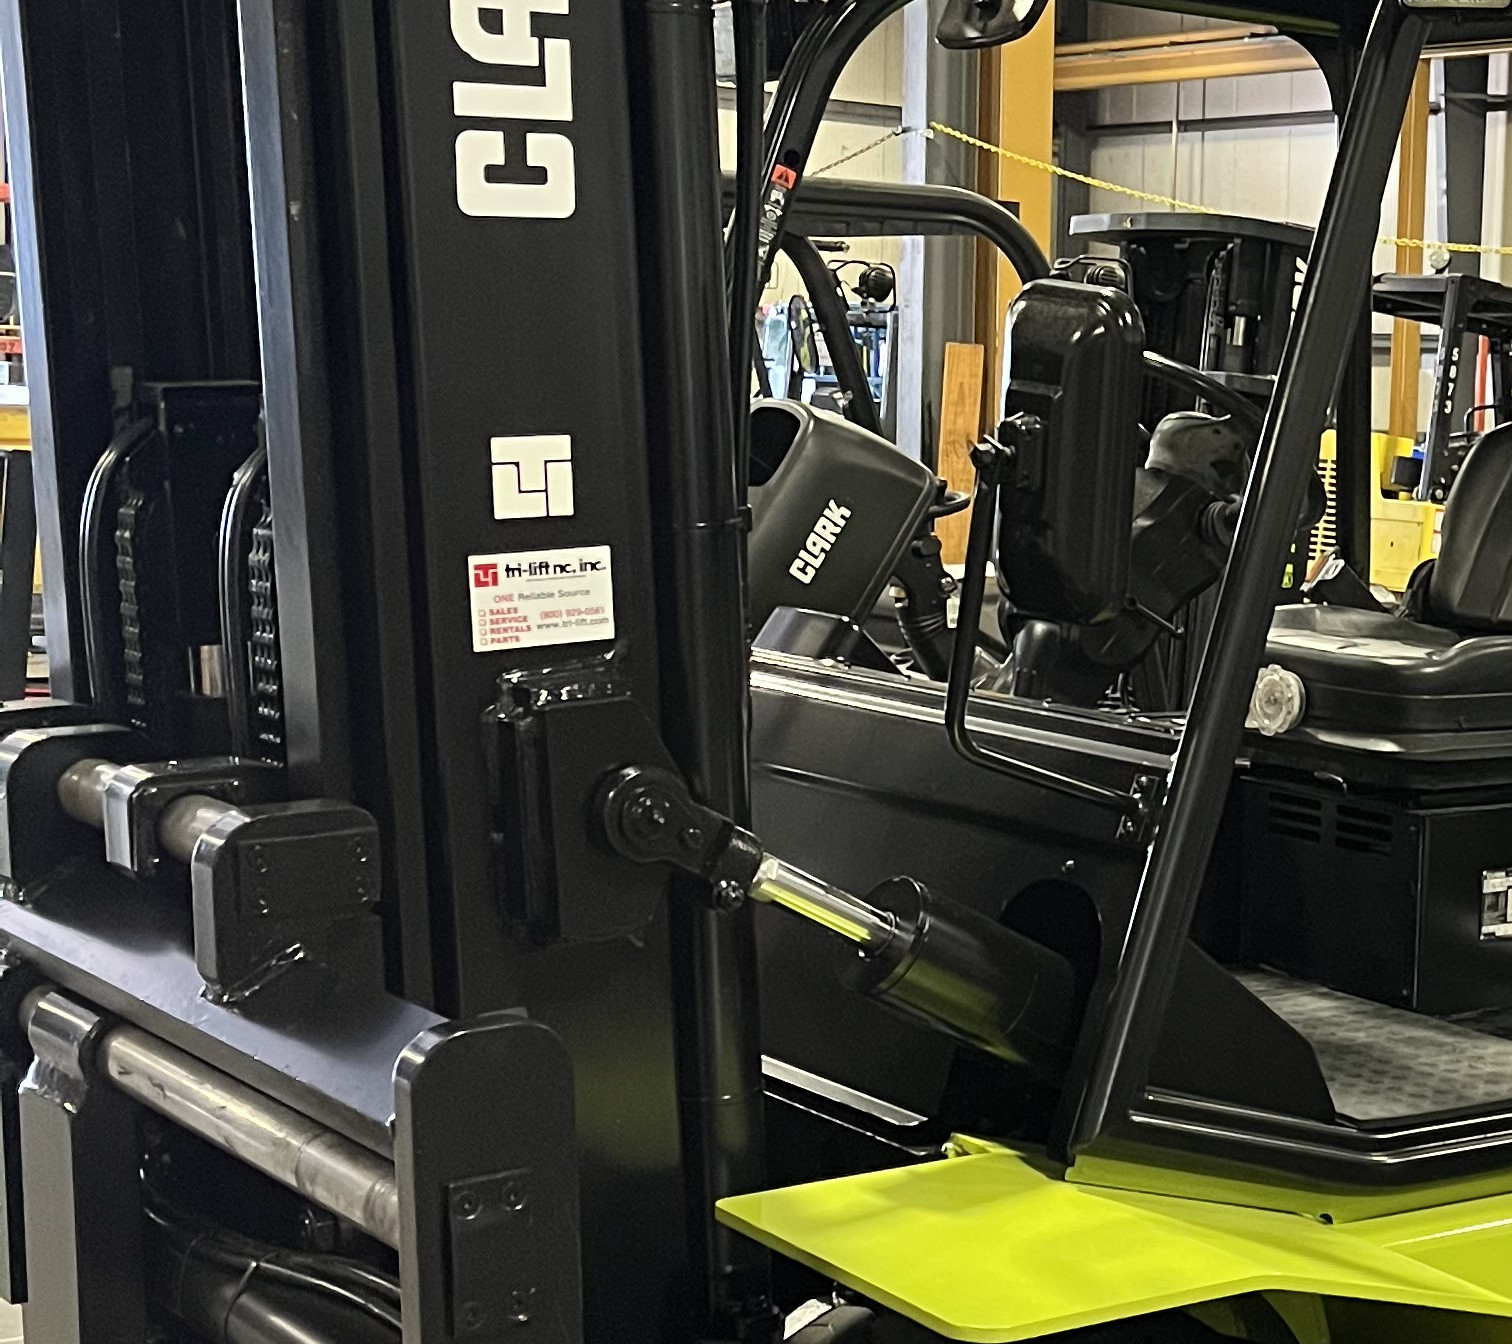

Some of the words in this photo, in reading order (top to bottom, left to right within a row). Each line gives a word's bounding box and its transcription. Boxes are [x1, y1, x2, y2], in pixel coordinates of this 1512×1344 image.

[789, 498, 851, 585] CLARK
[558, 589, 591, 598] Source
[489, 607, 519, 616] SALES
[489, 616, 529, 626] SERVICE
[489, 624, 532, 635] RENTALS
[490, 635, 520, 645] PARTS
